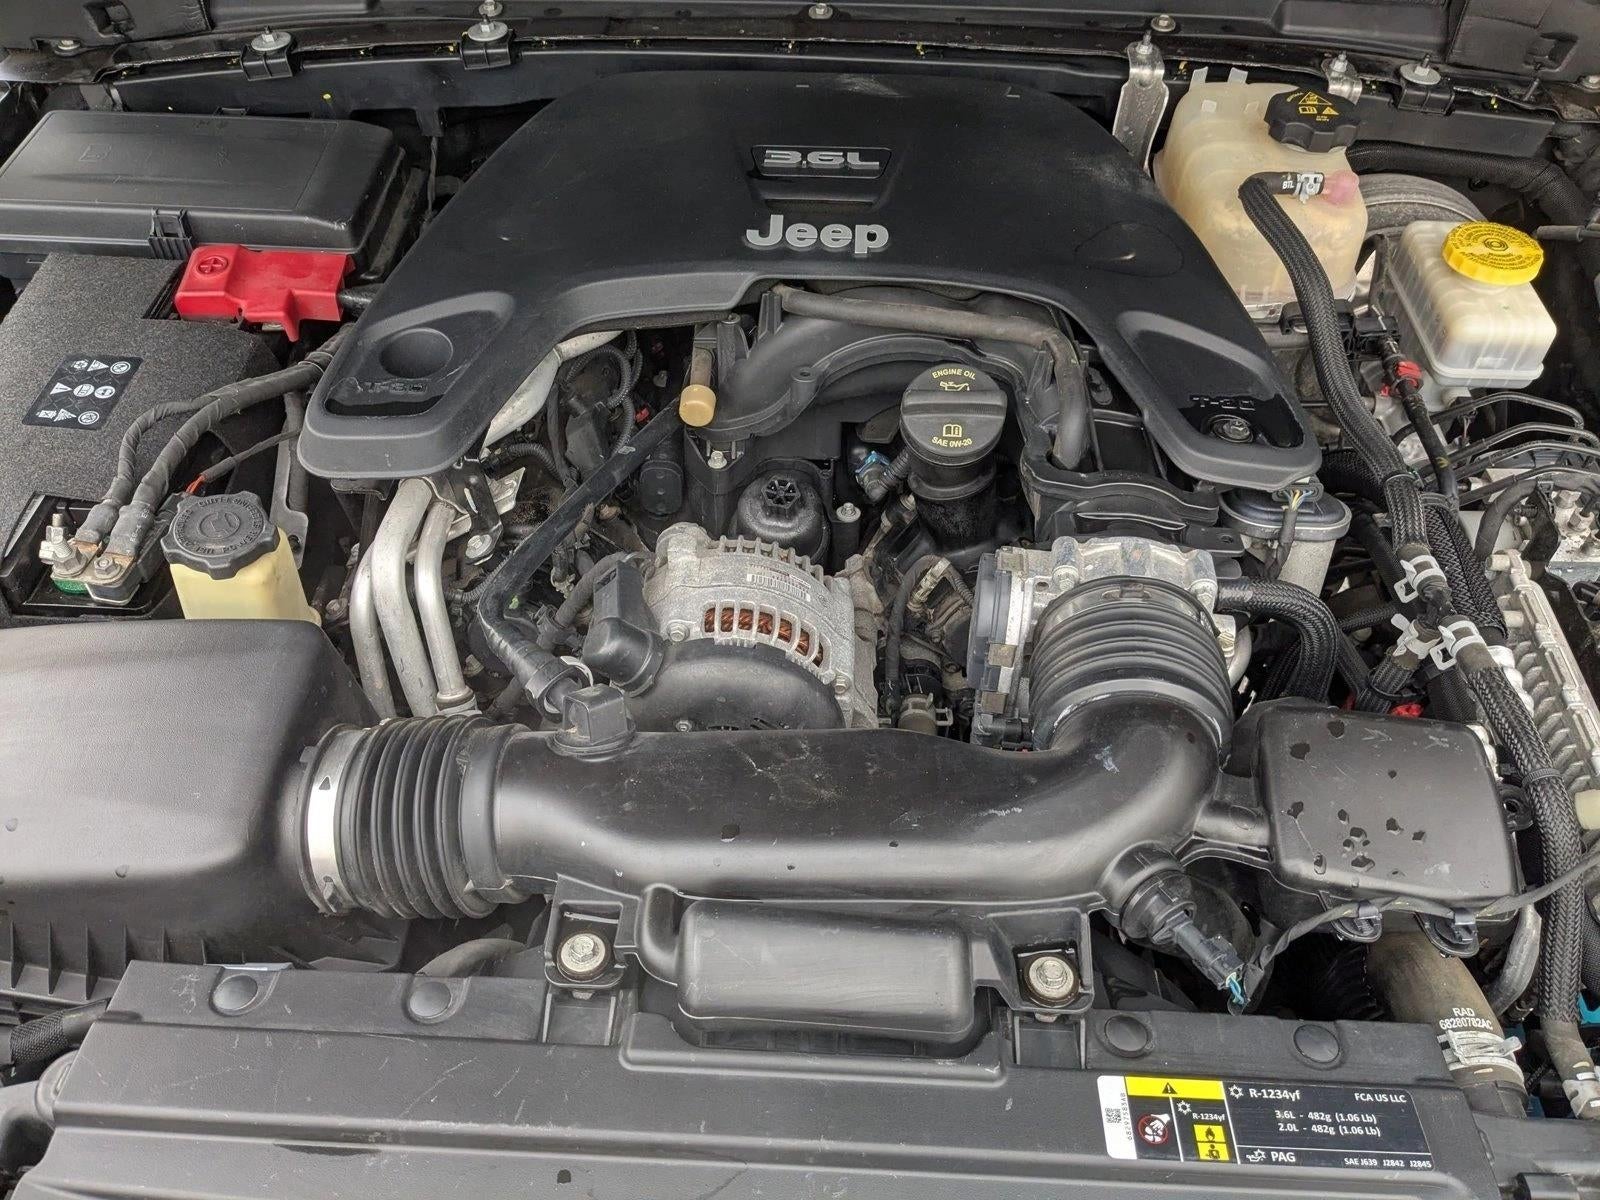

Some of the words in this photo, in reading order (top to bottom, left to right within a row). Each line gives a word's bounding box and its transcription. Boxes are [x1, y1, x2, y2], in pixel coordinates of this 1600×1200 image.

[763, 150, 880, 170] 3.6L
[745, 214, 890, 257] Jeep
[931, 368, 962, 380] ENGINE
[963, 370, 976, 380] OIL
[931, 436, 948, 447] SAE
[949, 437, 973, 448] 0W-20
[1453, 1008, 1475, 1016] RAD
[1439, 1018, 1493, 1030] 68280782AC
[1248, 1088, 1301, 1102] R-1234yf
[1354, 1092, 1374, 1102] FCA
[1374, 1093, 1389, 1102] US
[1389, 1094, 1407, 1103] LLC
[1192, 1112, 1226, 1122] R-1234yf
[1274, 1110, 1296, 1119] 3.6L
[1307, 1111, 1332, 1122] 482g
[1335, 1112, 1360, 1123] (1.06
[1360, 1113, 1377, 1124] Lb)
[1277, 1122, 1299, 1132] 2.0L
[1311, 1124, 1336, 1135] 482g
[1338, 1125, 1364, 1136] (1.06
[1364, 1126, 1381, 1137] Lb)
[1270, 1151, 1296, 1162] PAG
[1343, 1157, 1359, 1166] SAE
[1360, 1158, 1378, 1166] J639
[1382, 1159, 1405, 1167] J2842
[1409, 1160, 1432, 1168] J2845
